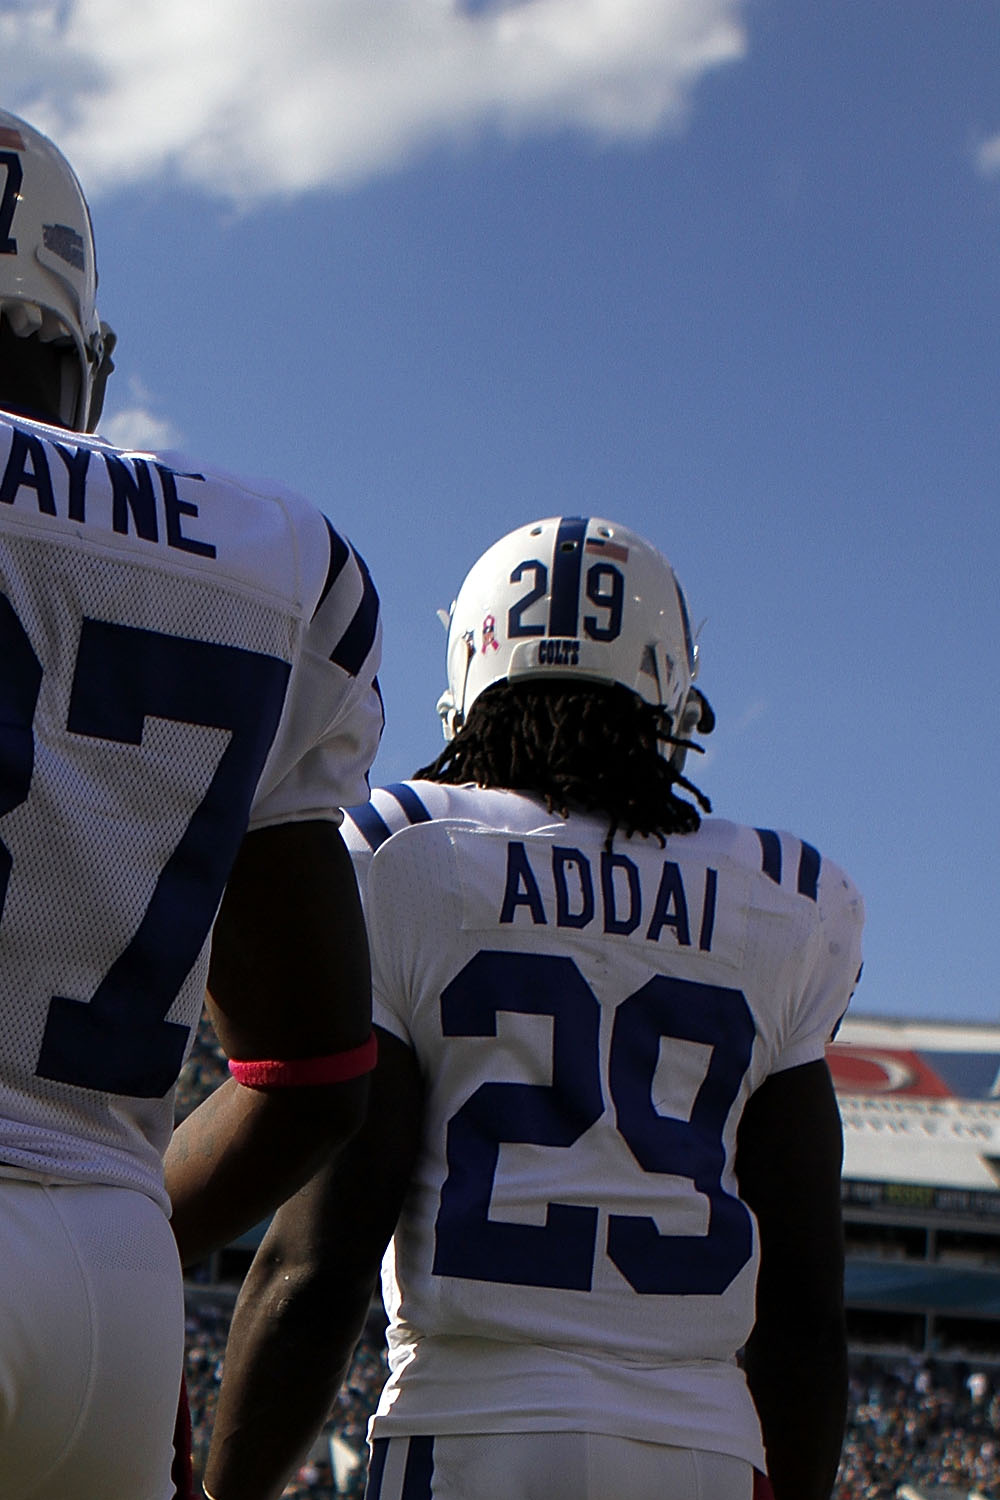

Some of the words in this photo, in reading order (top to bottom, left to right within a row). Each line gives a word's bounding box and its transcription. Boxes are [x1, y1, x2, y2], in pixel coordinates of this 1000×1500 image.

[507, 559, 625, 643] 29
[538, 639, 581, 666] COLTS
[499, 841, 718, 952] ADDAI
[432, 950, 756, 1296] 29
